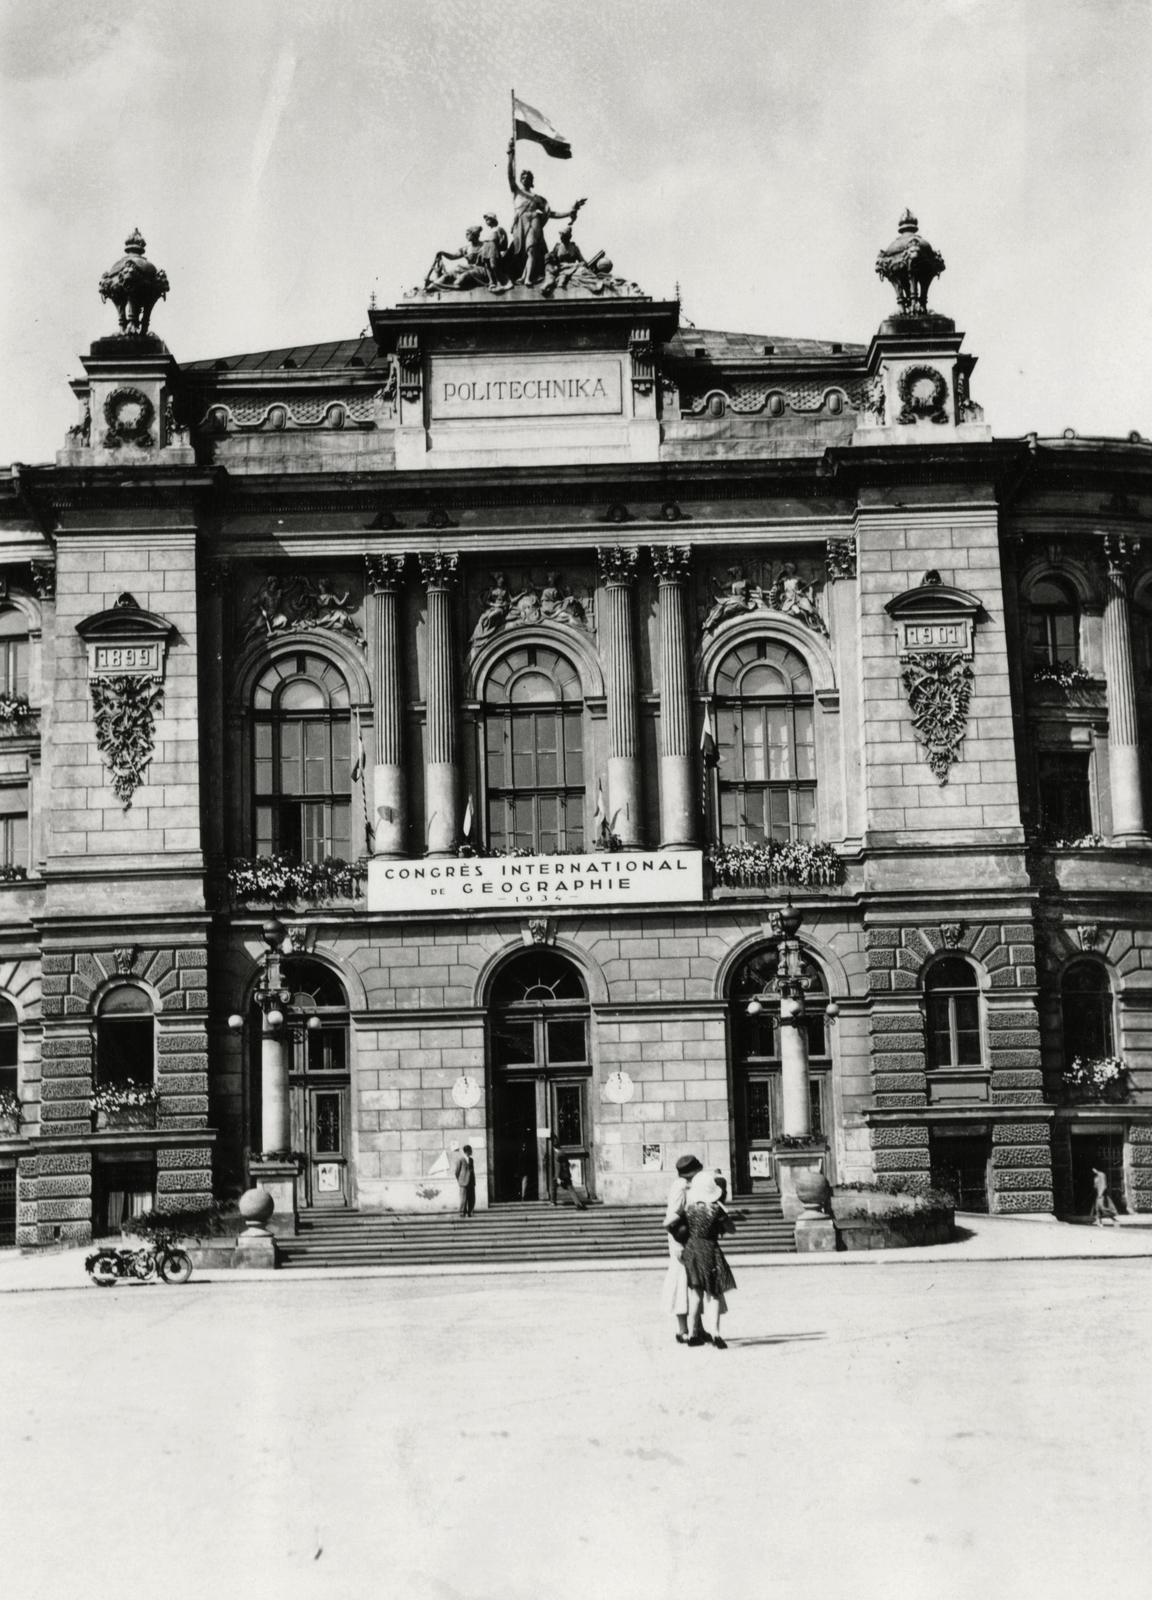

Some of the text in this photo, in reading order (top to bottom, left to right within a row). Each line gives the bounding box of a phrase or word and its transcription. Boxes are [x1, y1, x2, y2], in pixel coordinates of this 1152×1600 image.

[444, 378, 607, 401] POLITECHNIKA
[907, 626, 959, 644] 1901
[100, 648, 150, 667] 1899
[385, 859, 687, 880] CONGRÈS INTERNATIONAL
